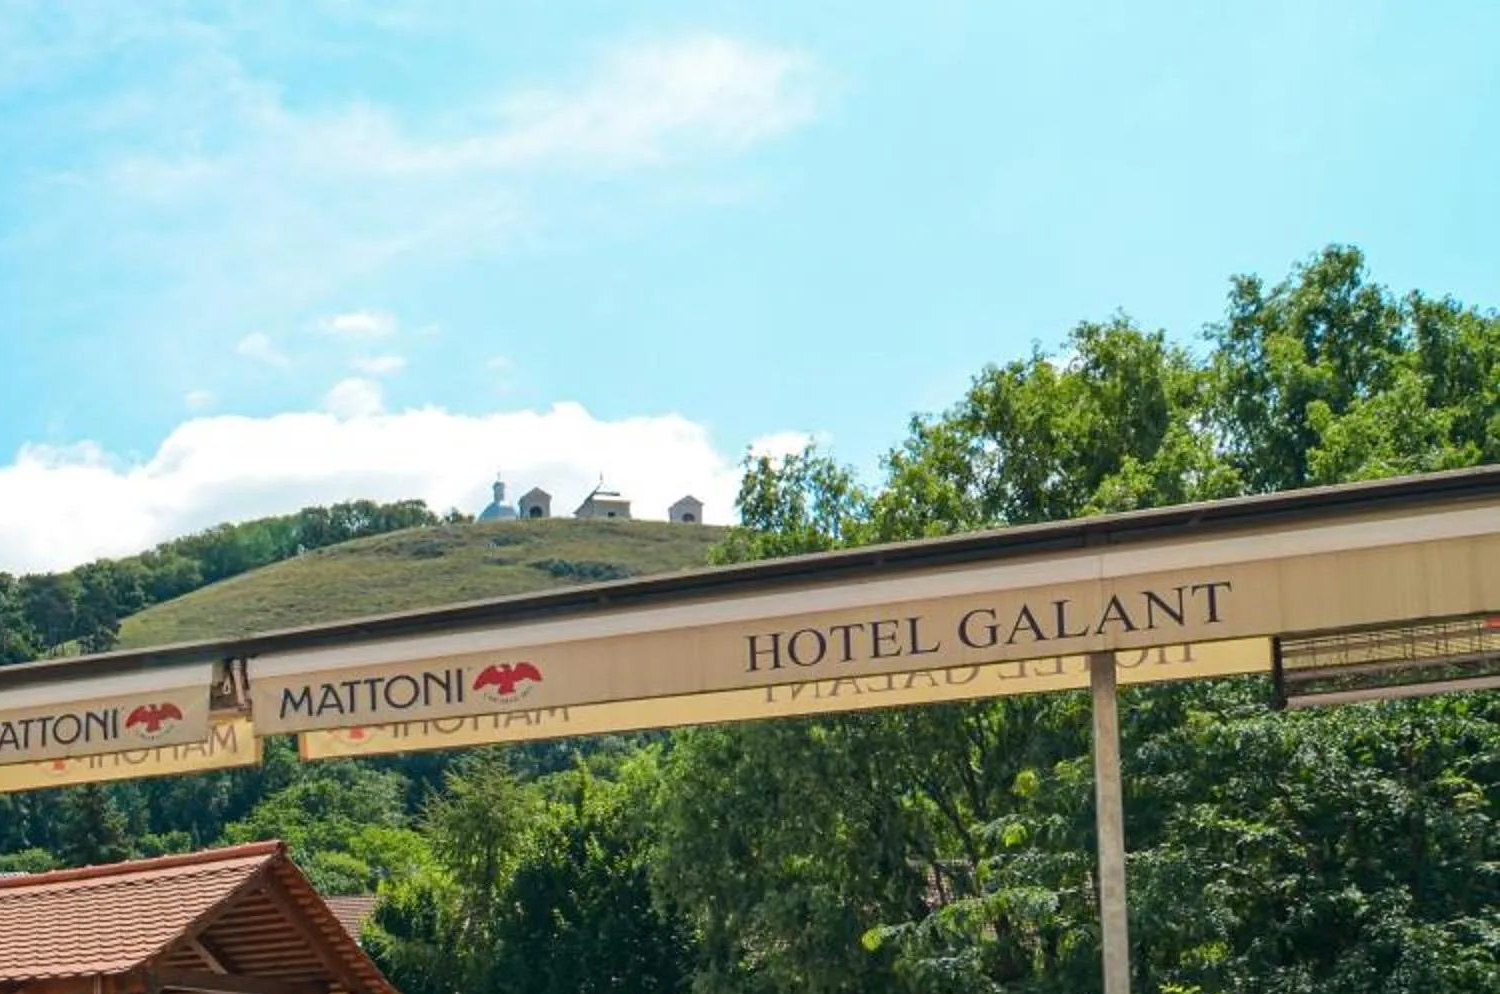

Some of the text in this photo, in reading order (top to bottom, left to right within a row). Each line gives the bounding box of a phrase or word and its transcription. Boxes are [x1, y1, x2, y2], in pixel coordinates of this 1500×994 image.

[745, 580, 1233, 674] HOTEL GALANT
[279, 667, 464, 721] MATTONI
